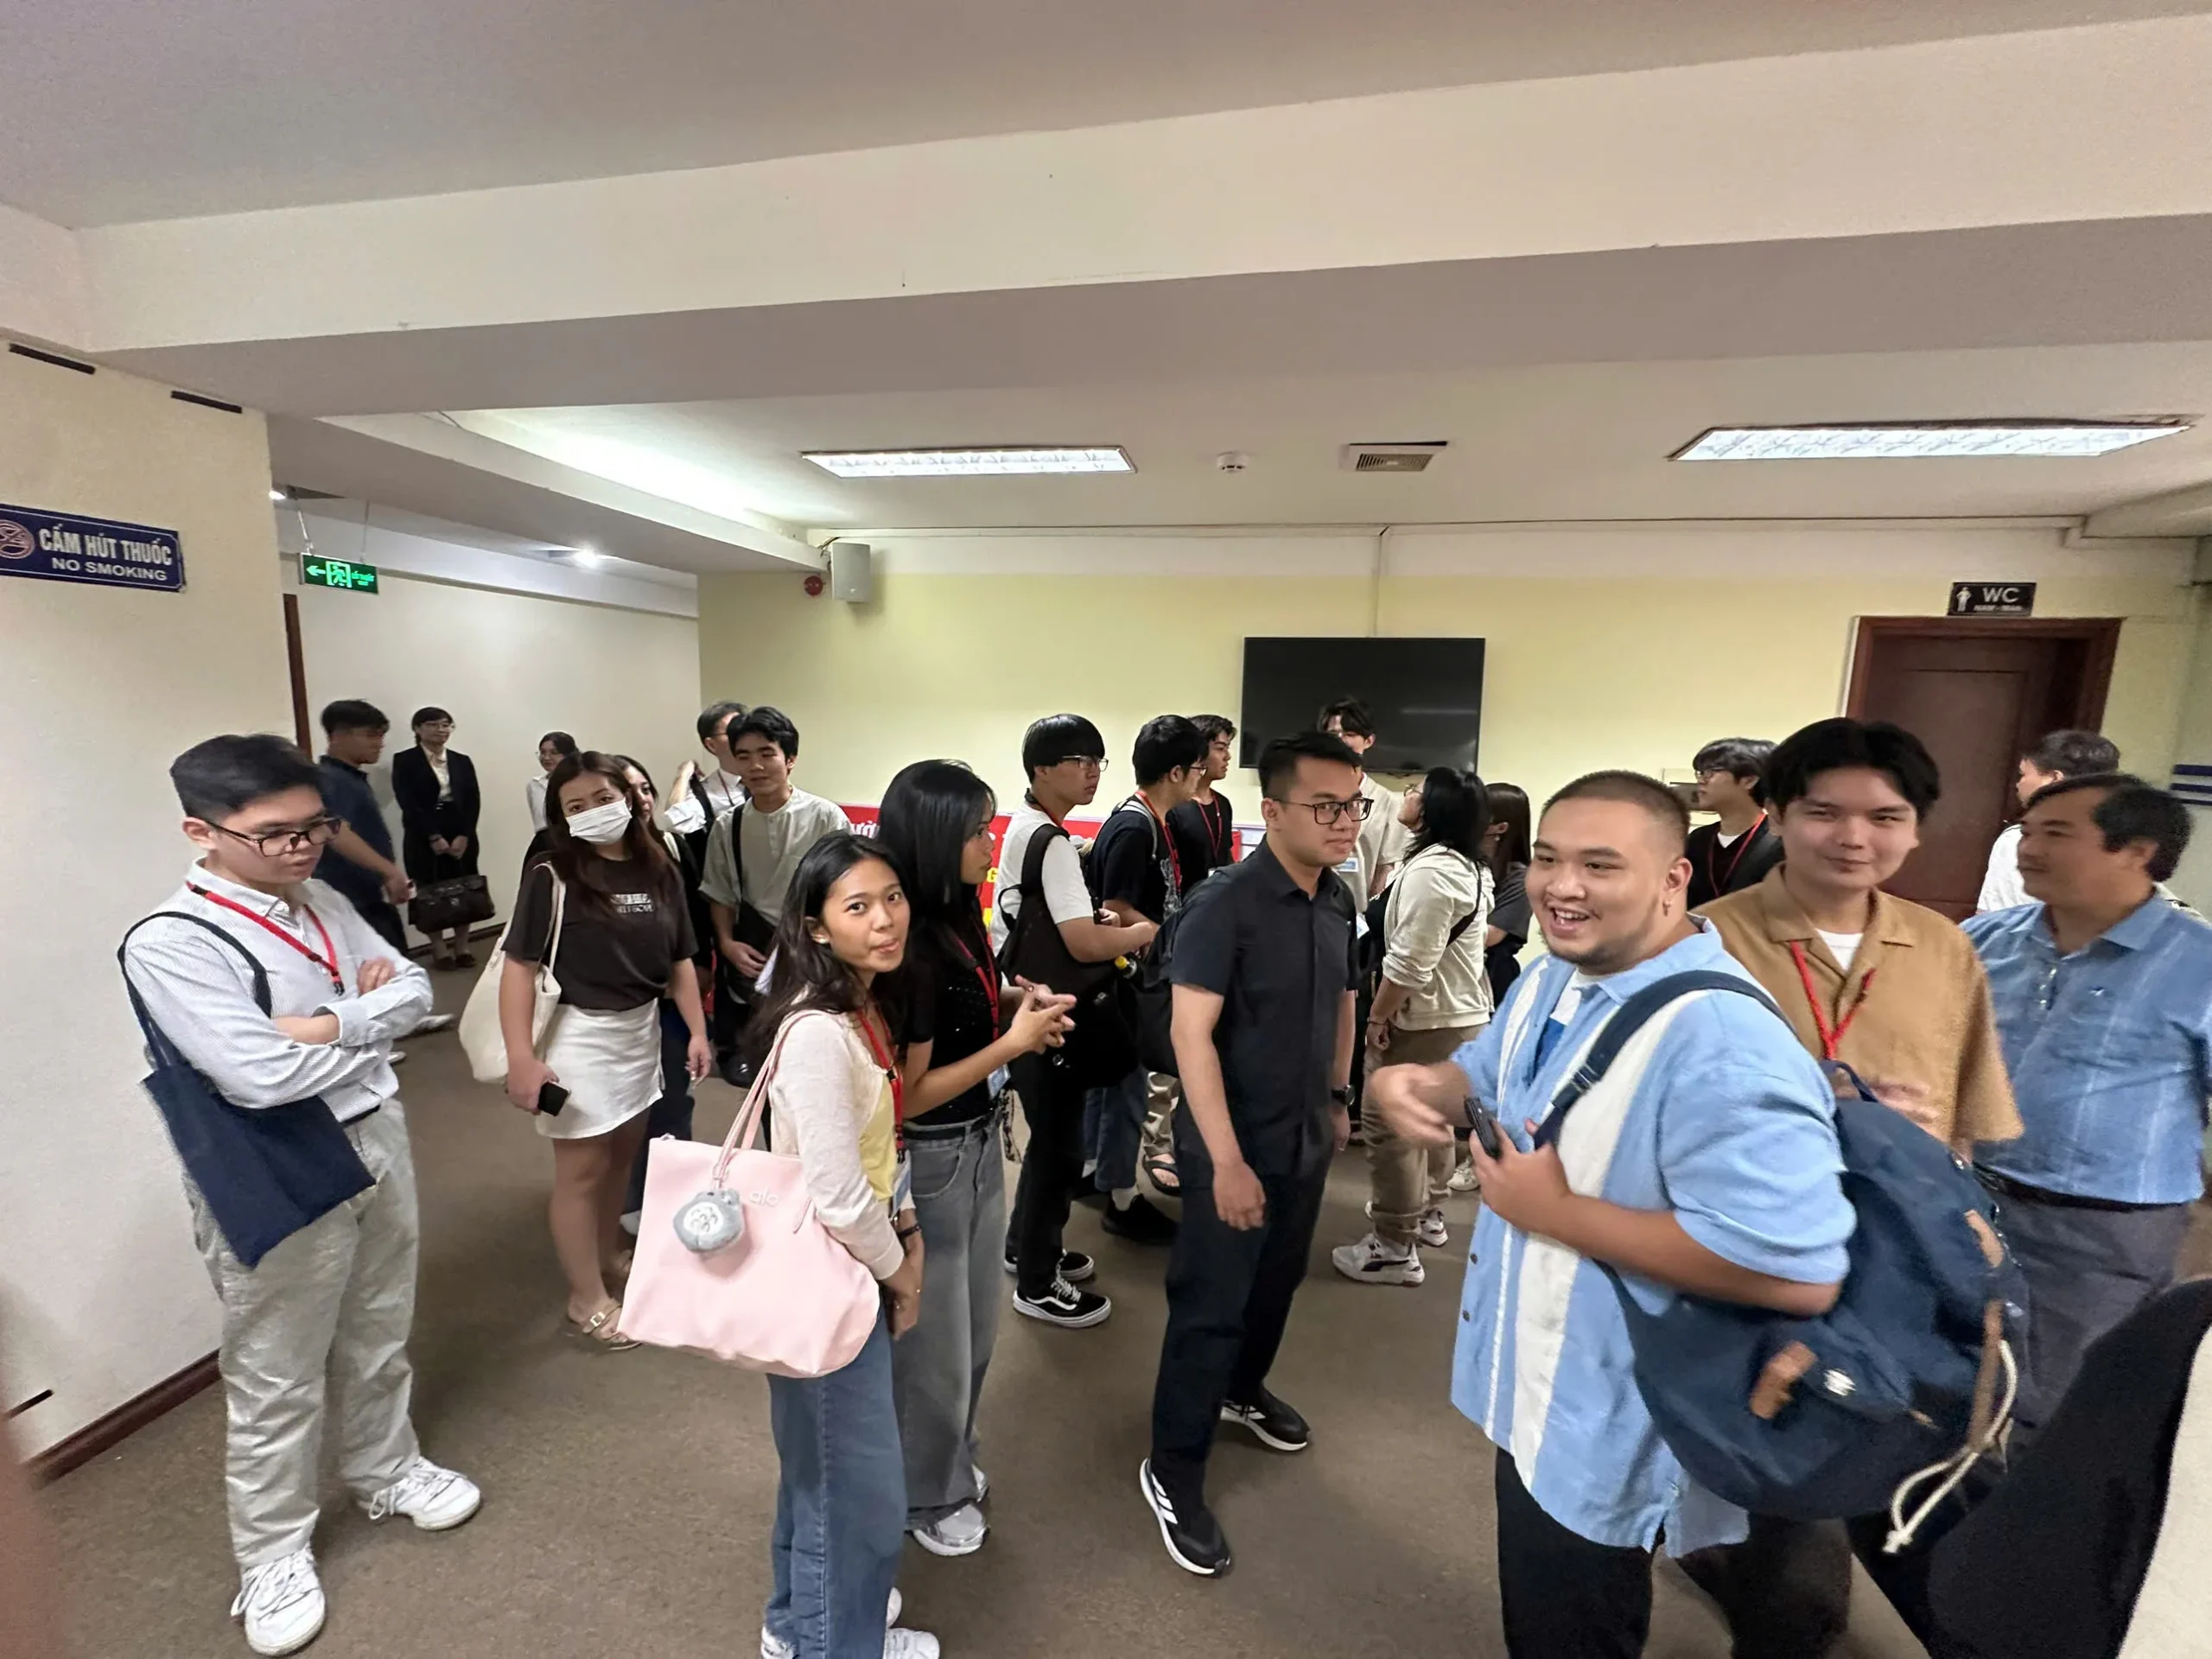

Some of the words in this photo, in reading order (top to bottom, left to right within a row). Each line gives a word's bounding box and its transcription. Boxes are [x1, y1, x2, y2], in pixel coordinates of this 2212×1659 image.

[39, 524, 82, 555] CẤM
[85, 532, 117, 559] HÚT
[120, 538, 172, 566] THUỐC
[52, 557, 80, 571] NO
[85, 562, 168, 581] SMOKING
[1982, 588, 2020, 603] WC
